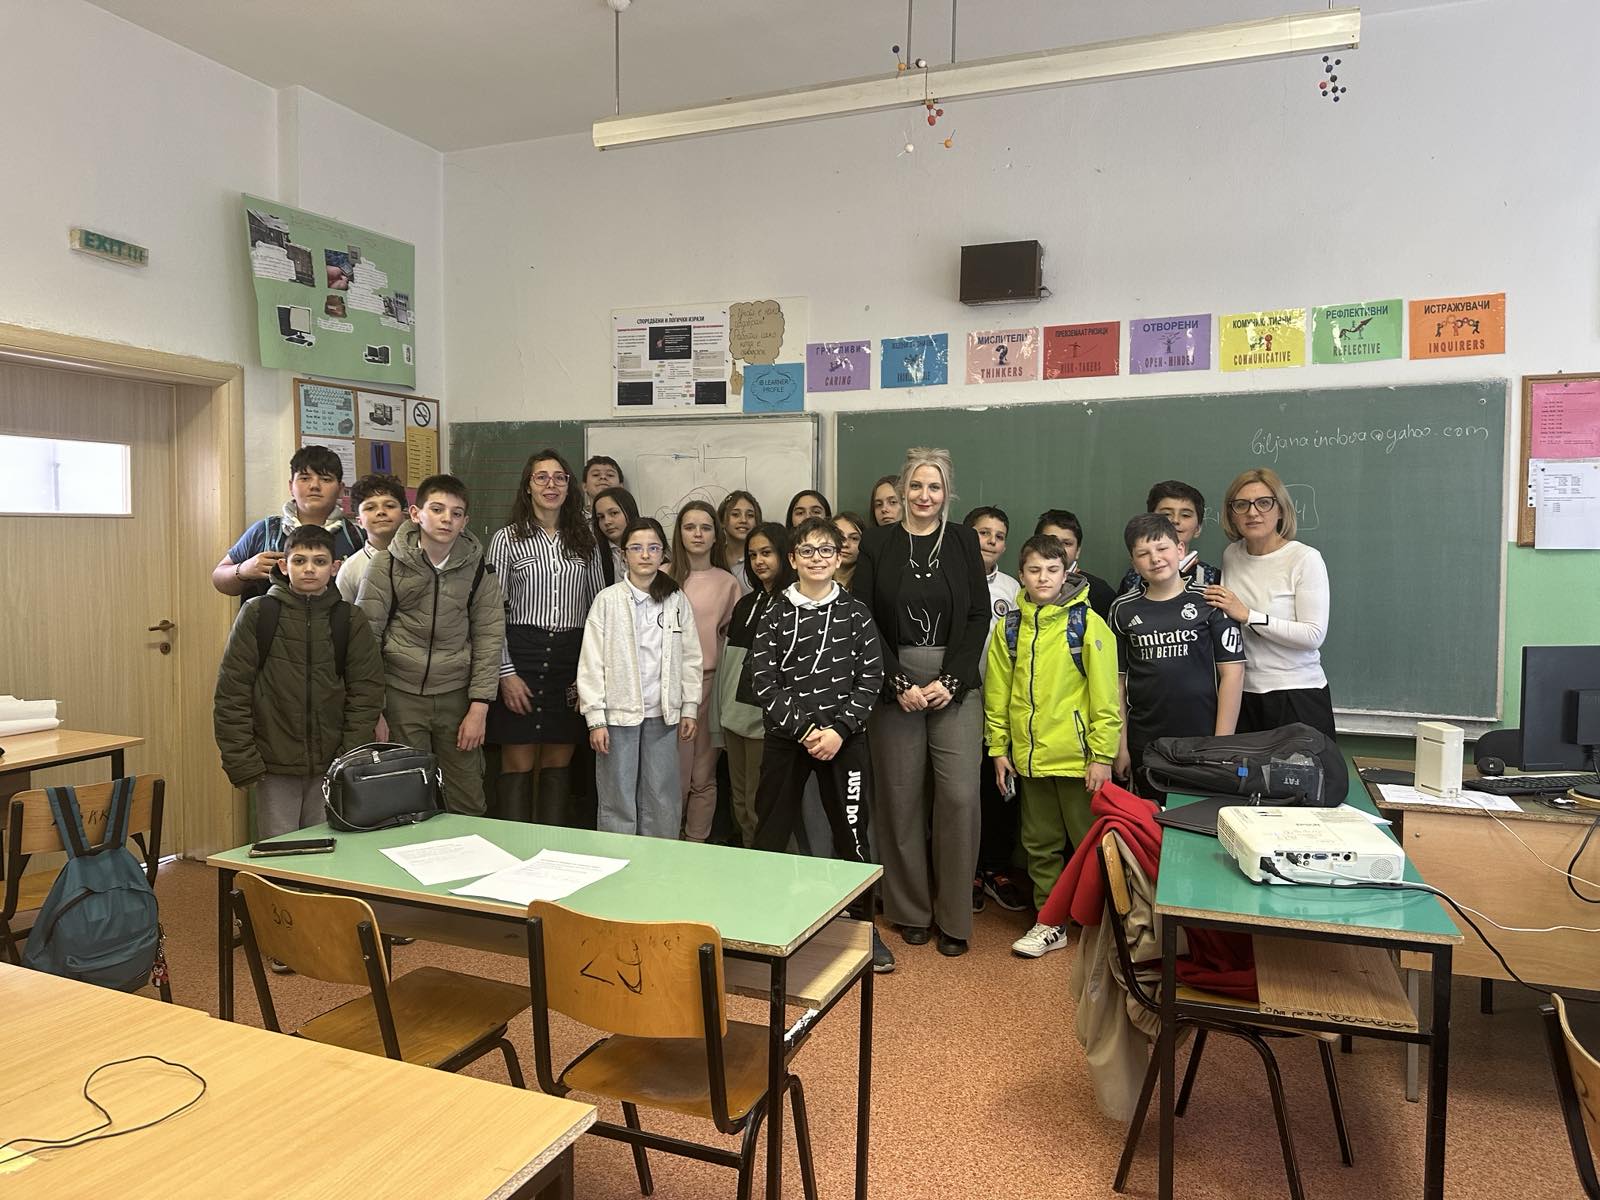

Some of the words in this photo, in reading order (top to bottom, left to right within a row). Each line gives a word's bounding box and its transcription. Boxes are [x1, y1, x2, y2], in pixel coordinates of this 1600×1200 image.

[1326, 305, 1388, 319] РЕФЛЕКТИВНИ
[1424, 300, 1490, 315] ИСТРАЖУВАЧИ
[1142, 320, 1199, 332] ОТВОРЕНИ
[1428, 339, 1485, 353] INQUIRERS
[1233, 351, 1291, 366] COMMUNICATIVE
[825, 375, 852, 386] CARING
[981, 367, 1023, 379] THINKERS
[1130, 629, 1199, 648] Emirates
[1141, 646, 1154, 660] FLY
[1156, 643, 1189, 658] BETTER
[847, 770, 861, 801] JUST
[846, 805, 859, 825] DO
